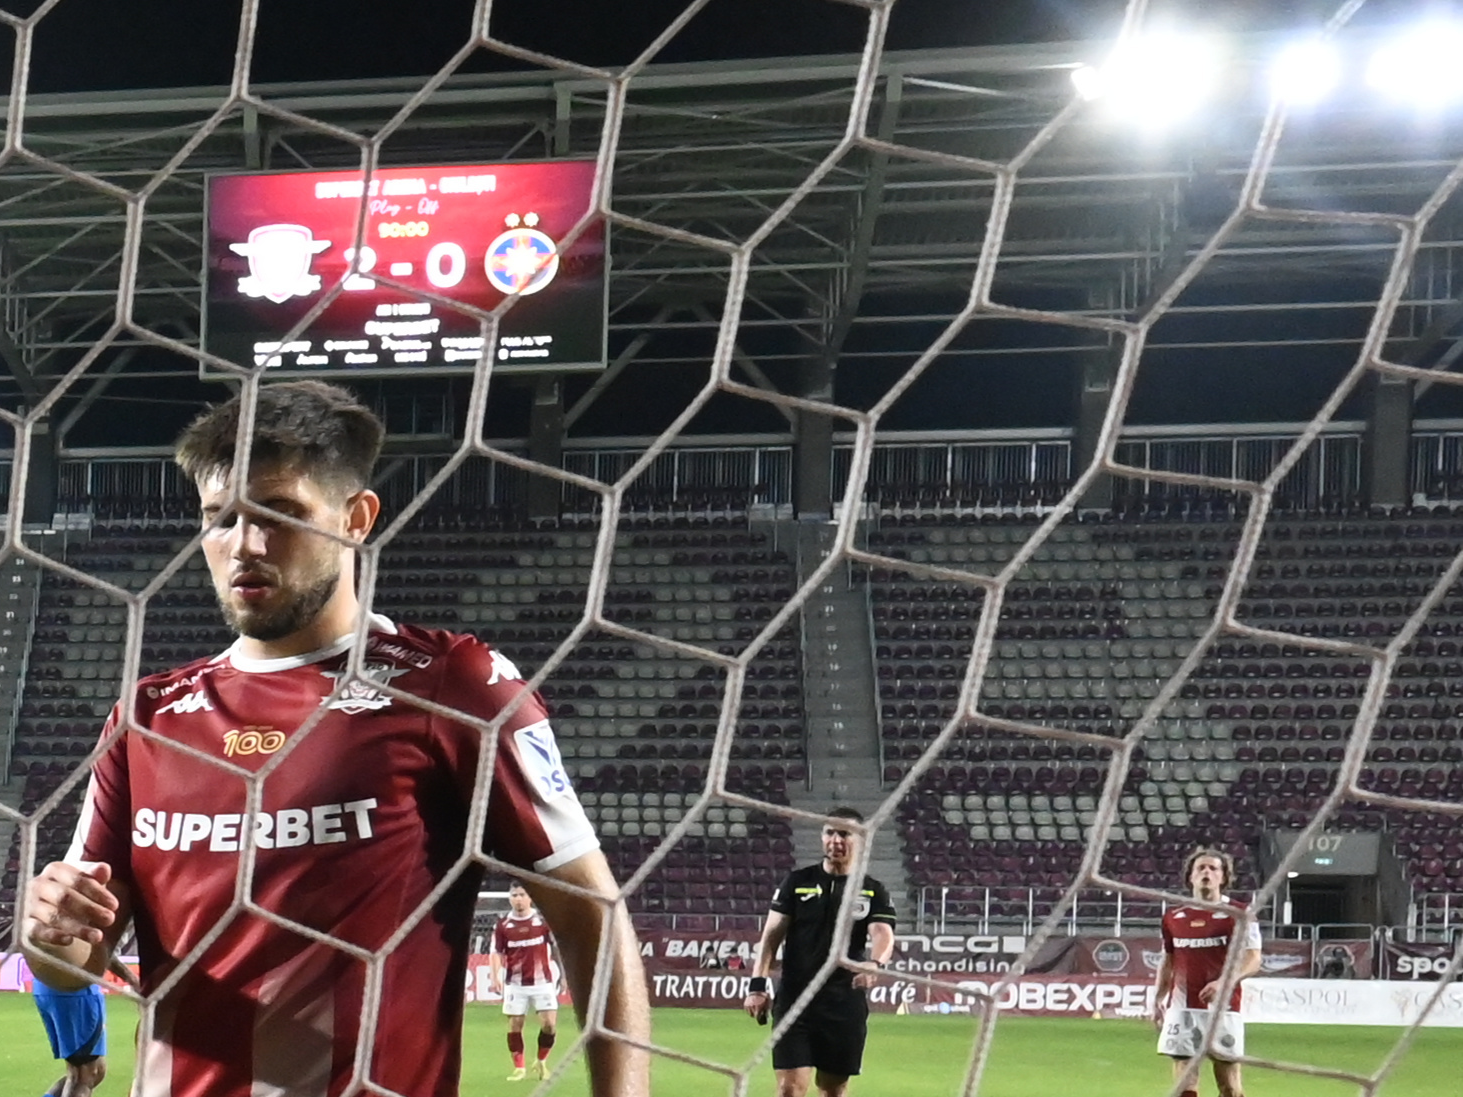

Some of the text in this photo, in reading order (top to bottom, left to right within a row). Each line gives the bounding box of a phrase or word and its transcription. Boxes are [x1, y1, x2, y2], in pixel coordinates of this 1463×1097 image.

[341, 246, 377, 291] 2
[425, 242, 466, 288] 0
[223, 729, 287, 757] 100
[132, 798, 378, 851] SUPERBET
[1308, 836, 1344, 852] 107
[653, 975, 776, 999] TRATTORA
[870, 981, 916, 1004] afé
[1260, 988, 1350, 1007] CASPOL
[1168, 1023, 1180, 1035] 25
